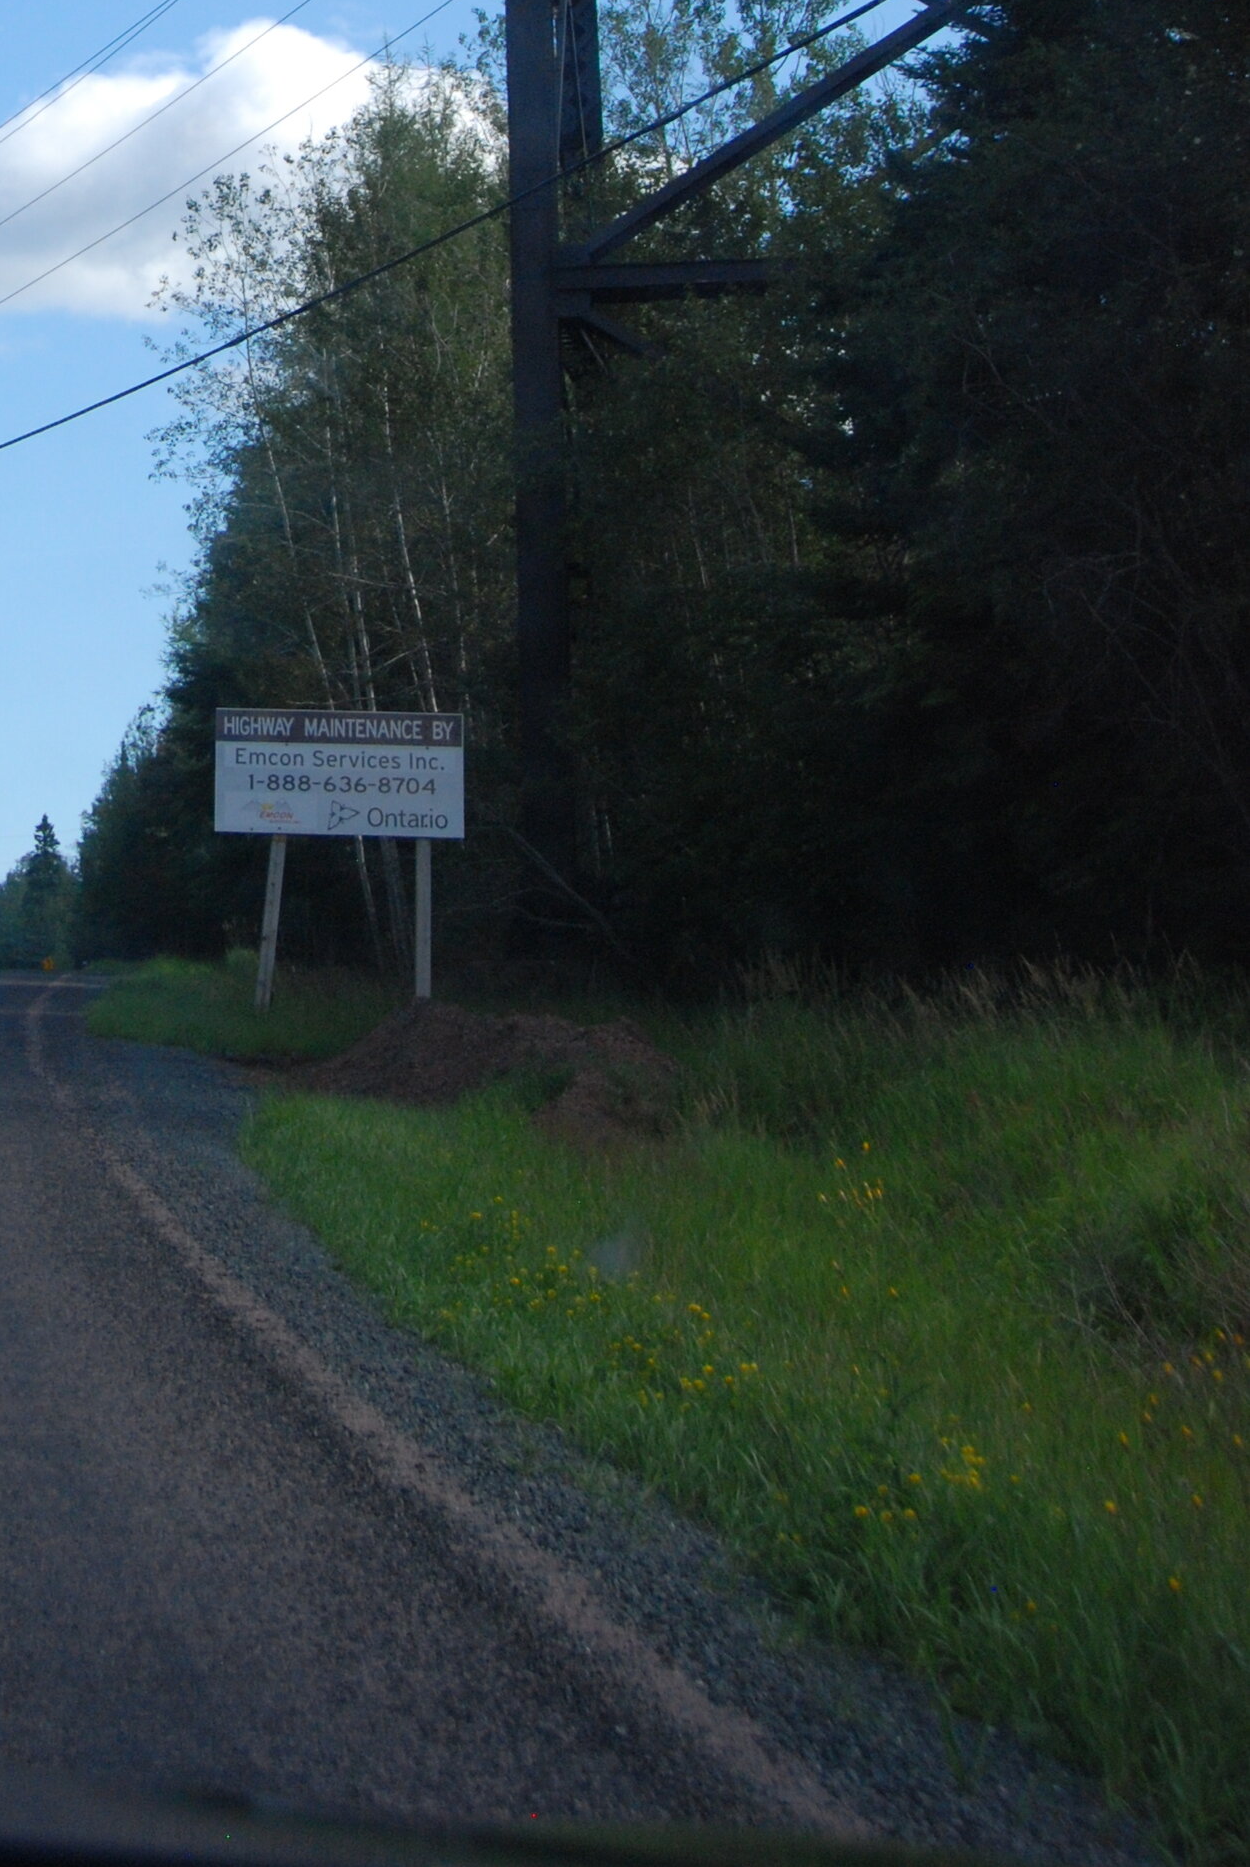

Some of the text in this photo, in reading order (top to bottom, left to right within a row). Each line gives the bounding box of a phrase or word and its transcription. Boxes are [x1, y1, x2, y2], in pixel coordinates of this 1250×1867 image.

[223, 716, 454, 740] HIGHWAY MAINTENANCE BY
[235, 748, 445, 771] Emcon Services Inc.
[248, 774, 437, 795] 1-888-636-8704
[367, 807, 449, 829] Ontario
